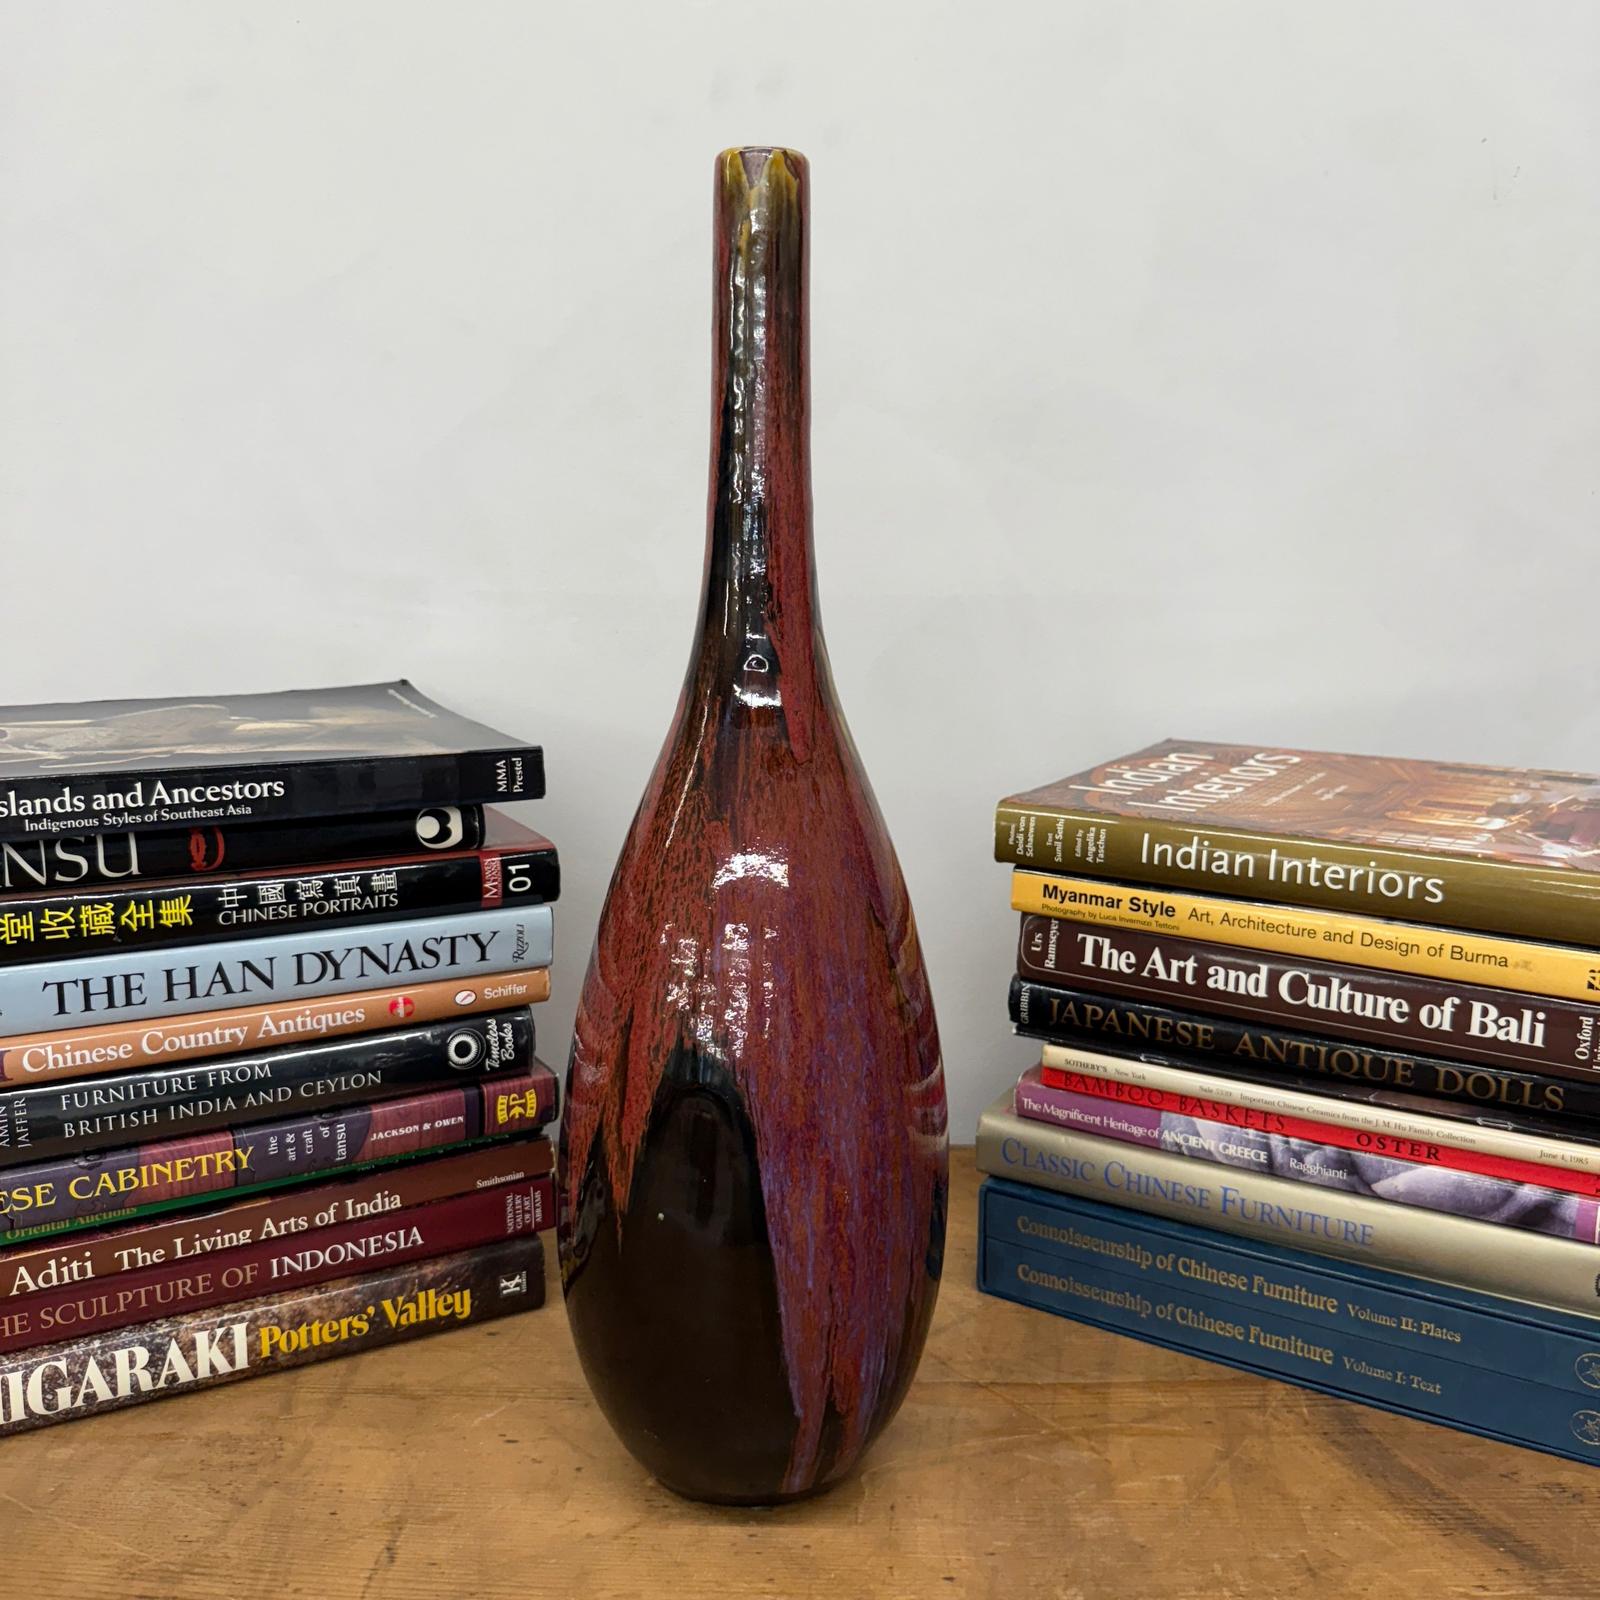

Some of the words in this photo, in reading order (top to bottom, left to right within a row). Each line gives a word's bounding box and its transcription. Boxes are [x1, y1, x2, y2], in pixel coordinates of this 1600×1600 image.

[92, 781, 145, 811] and
[150, 779, 285, 807] Ancestors
[495, 759, 508, 793] MMA
[511, 757, 524, 793] Prestel
[1068, 752, 1214, 796] Indian
[1126, 752, 1301, 813] Interiors
[24, 817, 100, 833] Indigenous
[103, 811, 142, 827] Styles
[144, 809, 159, 823] of
[161, 807, 225, 821] Southeast
[226, 804, 252, 817] Asia
[1025, 816, 1036, 857] Schaewen
[1054, 841, 1062, 863] Sunil
[1086, 827, 1096, 863] Angelika
[1096, 828, 1107, 864] Taschen
[507, 864, 531, 892] 01
[1141, 833, 1255, 877] Indian
[1268, 848, 1444, 903] Interiors
[0, 894, 194, 946] 堂收藏全集
[218, 903, 297, 926] CHINESE
[303, 893, 399, 917] PORTRAITS
[1042, 903, 1086, 918] Photography
[1088, 909, 1096, 920] by
[1099, 913, 1117, 921] Luca
[1154, 920, 1180, 931] Tettoni
[1043, 884, 1123, 910] Myanmar
[1128, 897, 1176, 918] Style
[1188, 907, 1214, 926] Art,
[1219, 912, 1317, 939] Architecture
[1323, 930, 1354, 945] and
[1360, 932, 1420, 957] Design
[1426, 943, 1444, 958] of
[1450, 945, 1509, 968] Burma
[1031, 932, 1043, 952] Urs
[1044, 918, 1060, 969] Ramseyer
[41, 972, 148, 1016] THE
[162, 957, 277, 1003] HAN
[292, 931, 500, 986] DYNASTY
[484, 983, 529, 1000] Schiffer
[1077, 933, 1137, 975] The
[1140, 946, 1198, 985] Art
[1207, 964, 1268, 998] and
[1278, 970, 1410, 1023] Culture
[1419, 997, 1460, 1031] of
[1465, 1000, 1546, 1048] Bali
[1020, 984, 1030, 1025] GRIBBIN
[23, 1046, 133, 1073] Chinese
[141, 1025, 248, 1055] Country
[257, 1008, 366, 1039] Antiques
[485, 1018, 500, 1071] Timeless
[499, 1022, 515, 1061] Books
[1050, 997, 1215, 1050] JAPANESE
[1233, 1031, 1416, 1086] ANTIQUE
[1433, 1066, 1565, 1112] DOLLS
[1574, 1016, 1594, 1060] Oxford
[61, 1074, 198, 1111] FURNITURE
[208, 1063, 273, 1087] FROM
[63, 1109, 158, 1138] BRITISH
[170, 1096, 237, 1120] INDIA
[244, 1086, 292, 1109] AND
[300, 1070, 383, 1098] CEYLON
[14, 1097, 32, 1148] JAFFER
[371, 1124, 420, 1141] JACKSON
[422, 1122, 431, 1131] &
[434, 1116, 464, 1128] OWEN
[1063, 1072, 1165, 1106] BAMBOO
[1178, 1094, 1286, 1132] BASKETS
[1356, 1133, 1441, 1161] OSTER
[1064, 1057, 1108, 1074] SOTHEBY'S
[1114, 1068, 1131, 1078] New
[1131, 1071, 1147, 1081] York
[1240, 1093, 1276, 1106] Important
[1277, 1100, 1305, 1112] Chinese
[1306, 1106, 1341, 1119] Ceramics
[1342, 1113, 1360, 1124] from
[1361, 1116, 1373, 1125] the
[1407, 1125, 1435, 1138] Family
[1435, 1130, 1477, 1145] Collection
[1539, 1149, 1558, 1160] June
[268, 1135, 278, 1155] the
[286, 1133, 295, 1143] &
[286, 1146, 296, 1161] art
[302, 1129, 313, 1154] craft
[336, 1123, 347, 1161] tansu
[1022, 1097, 1042, 1112] The
[1043, 1102, 1102, 1127] Magnificent
[1103, 1112, 1148, 1138] Heritage
[1147, 1127, 1160, 1139] of
[1161, 1129, 1217, 1153] ANCIENT
[1218, 1142, 1269, 1163] GREECE
[1289, 1157, 1348, 1181] Ragghianti
[68, 1146, 255, 1200] CABINETRY
[476, 1170, 525, 1189] Smithsonian
[1002, 1137, 1096, 1181] CLASSIC
[1103, 1161, 1211, 1208] CHINESE
[1219, 1186, 1374, 1246] FURNITURE
[505, 1192, 515, 1234] NATIONAL
[514, 1194, 523, 1230] GALLERY
[534, 1190, 542, 1223] ABRAMS
[6, 1218, 70, 1239] Oriental
[9, 1251, 96, 1296] Aditi
[115, 1246, 166, 1271] The
[174, 1228, 252, 1260] Living
[259, 1215, 308, 1241] Arts
[315, 1202, 339, 1226] of
[345, 1190, 402, 1219] India
[39, 1273, 214, 1329] SCULPTURE
[221, 1264, 259, 1289] OF
[270, 1226, 424, 1278] INDONESIA
[1017, 1215, 1153, 1270] Connoisseurship
[1156, 1253, 1175, 1271] of
[1178, 1257, 1248, 1290] Chinese
[1252, 1275, 1339, 1313] Furniture
[1347, 1303, 1397, 1327] Volume
[1400, 1317, 1417, 1332] II:
[1420, 1321, 1461, 1342] Plates
[1017, 1263, 1152, 1318] Connoisseurship
[1156, 1303, 1175, 1321] of
[1176, 1305, 1245, 1340] Chinese
[1248, 1325, 1335, 1366] Furniture
[1342, 1355, 1393, 1382] Volume
[1395, 1371, 1406, 1385] I:
[1410, 1375, 1442, 1395] Text
[0, 1321, 249, 1426] IGARAKI
[382, 1288, 472, 1330] Valley
